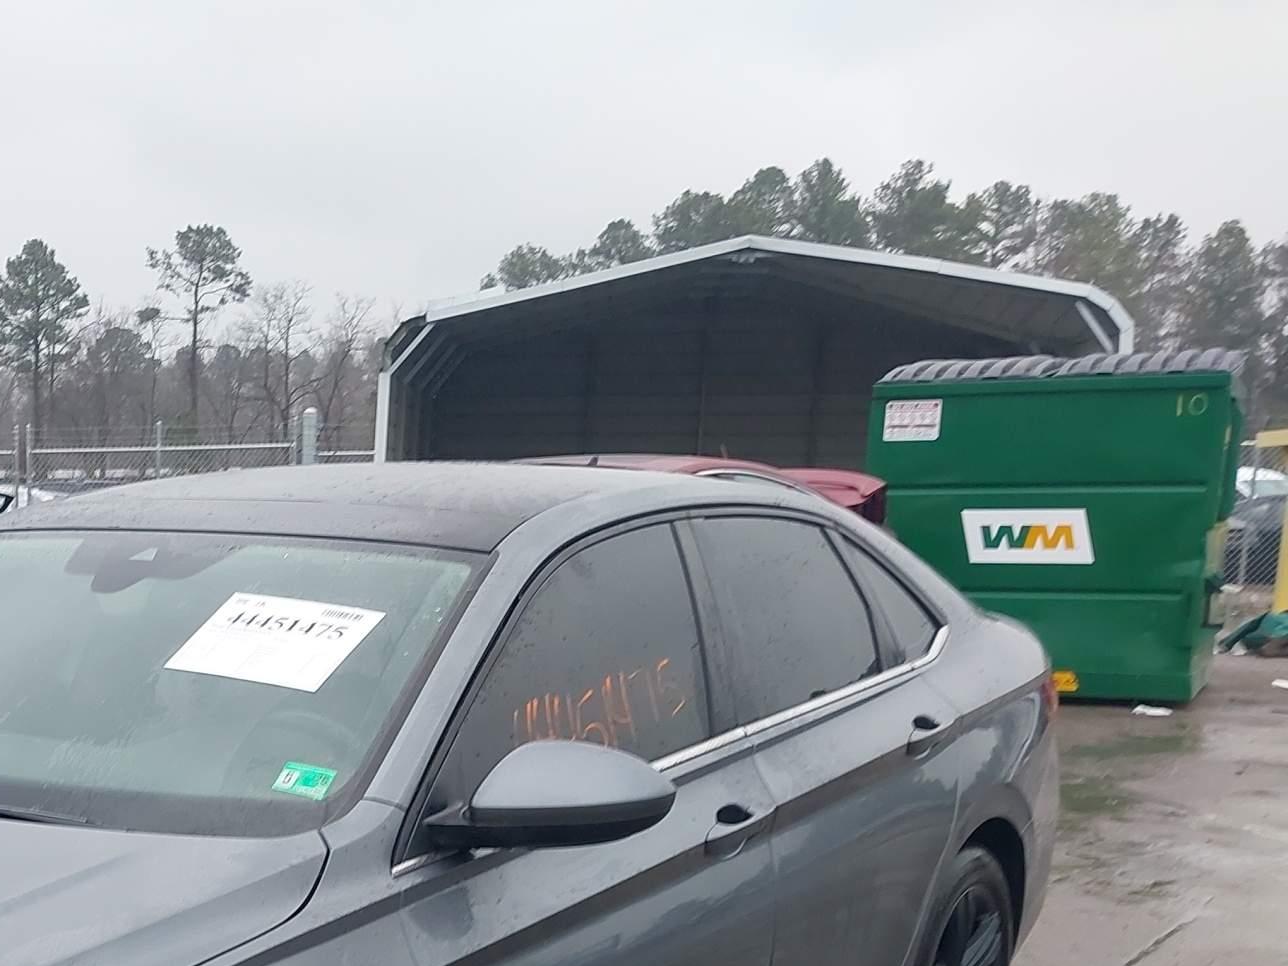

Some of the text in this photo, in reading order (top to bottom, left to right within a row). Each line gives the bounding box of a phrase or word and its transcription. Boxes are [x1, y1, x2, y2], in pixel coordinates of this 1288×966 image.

[1176, 393, 1209, 417] 10
[981, 525, 1074, 549] WM
[226, 611, 349, 641] 44451475
